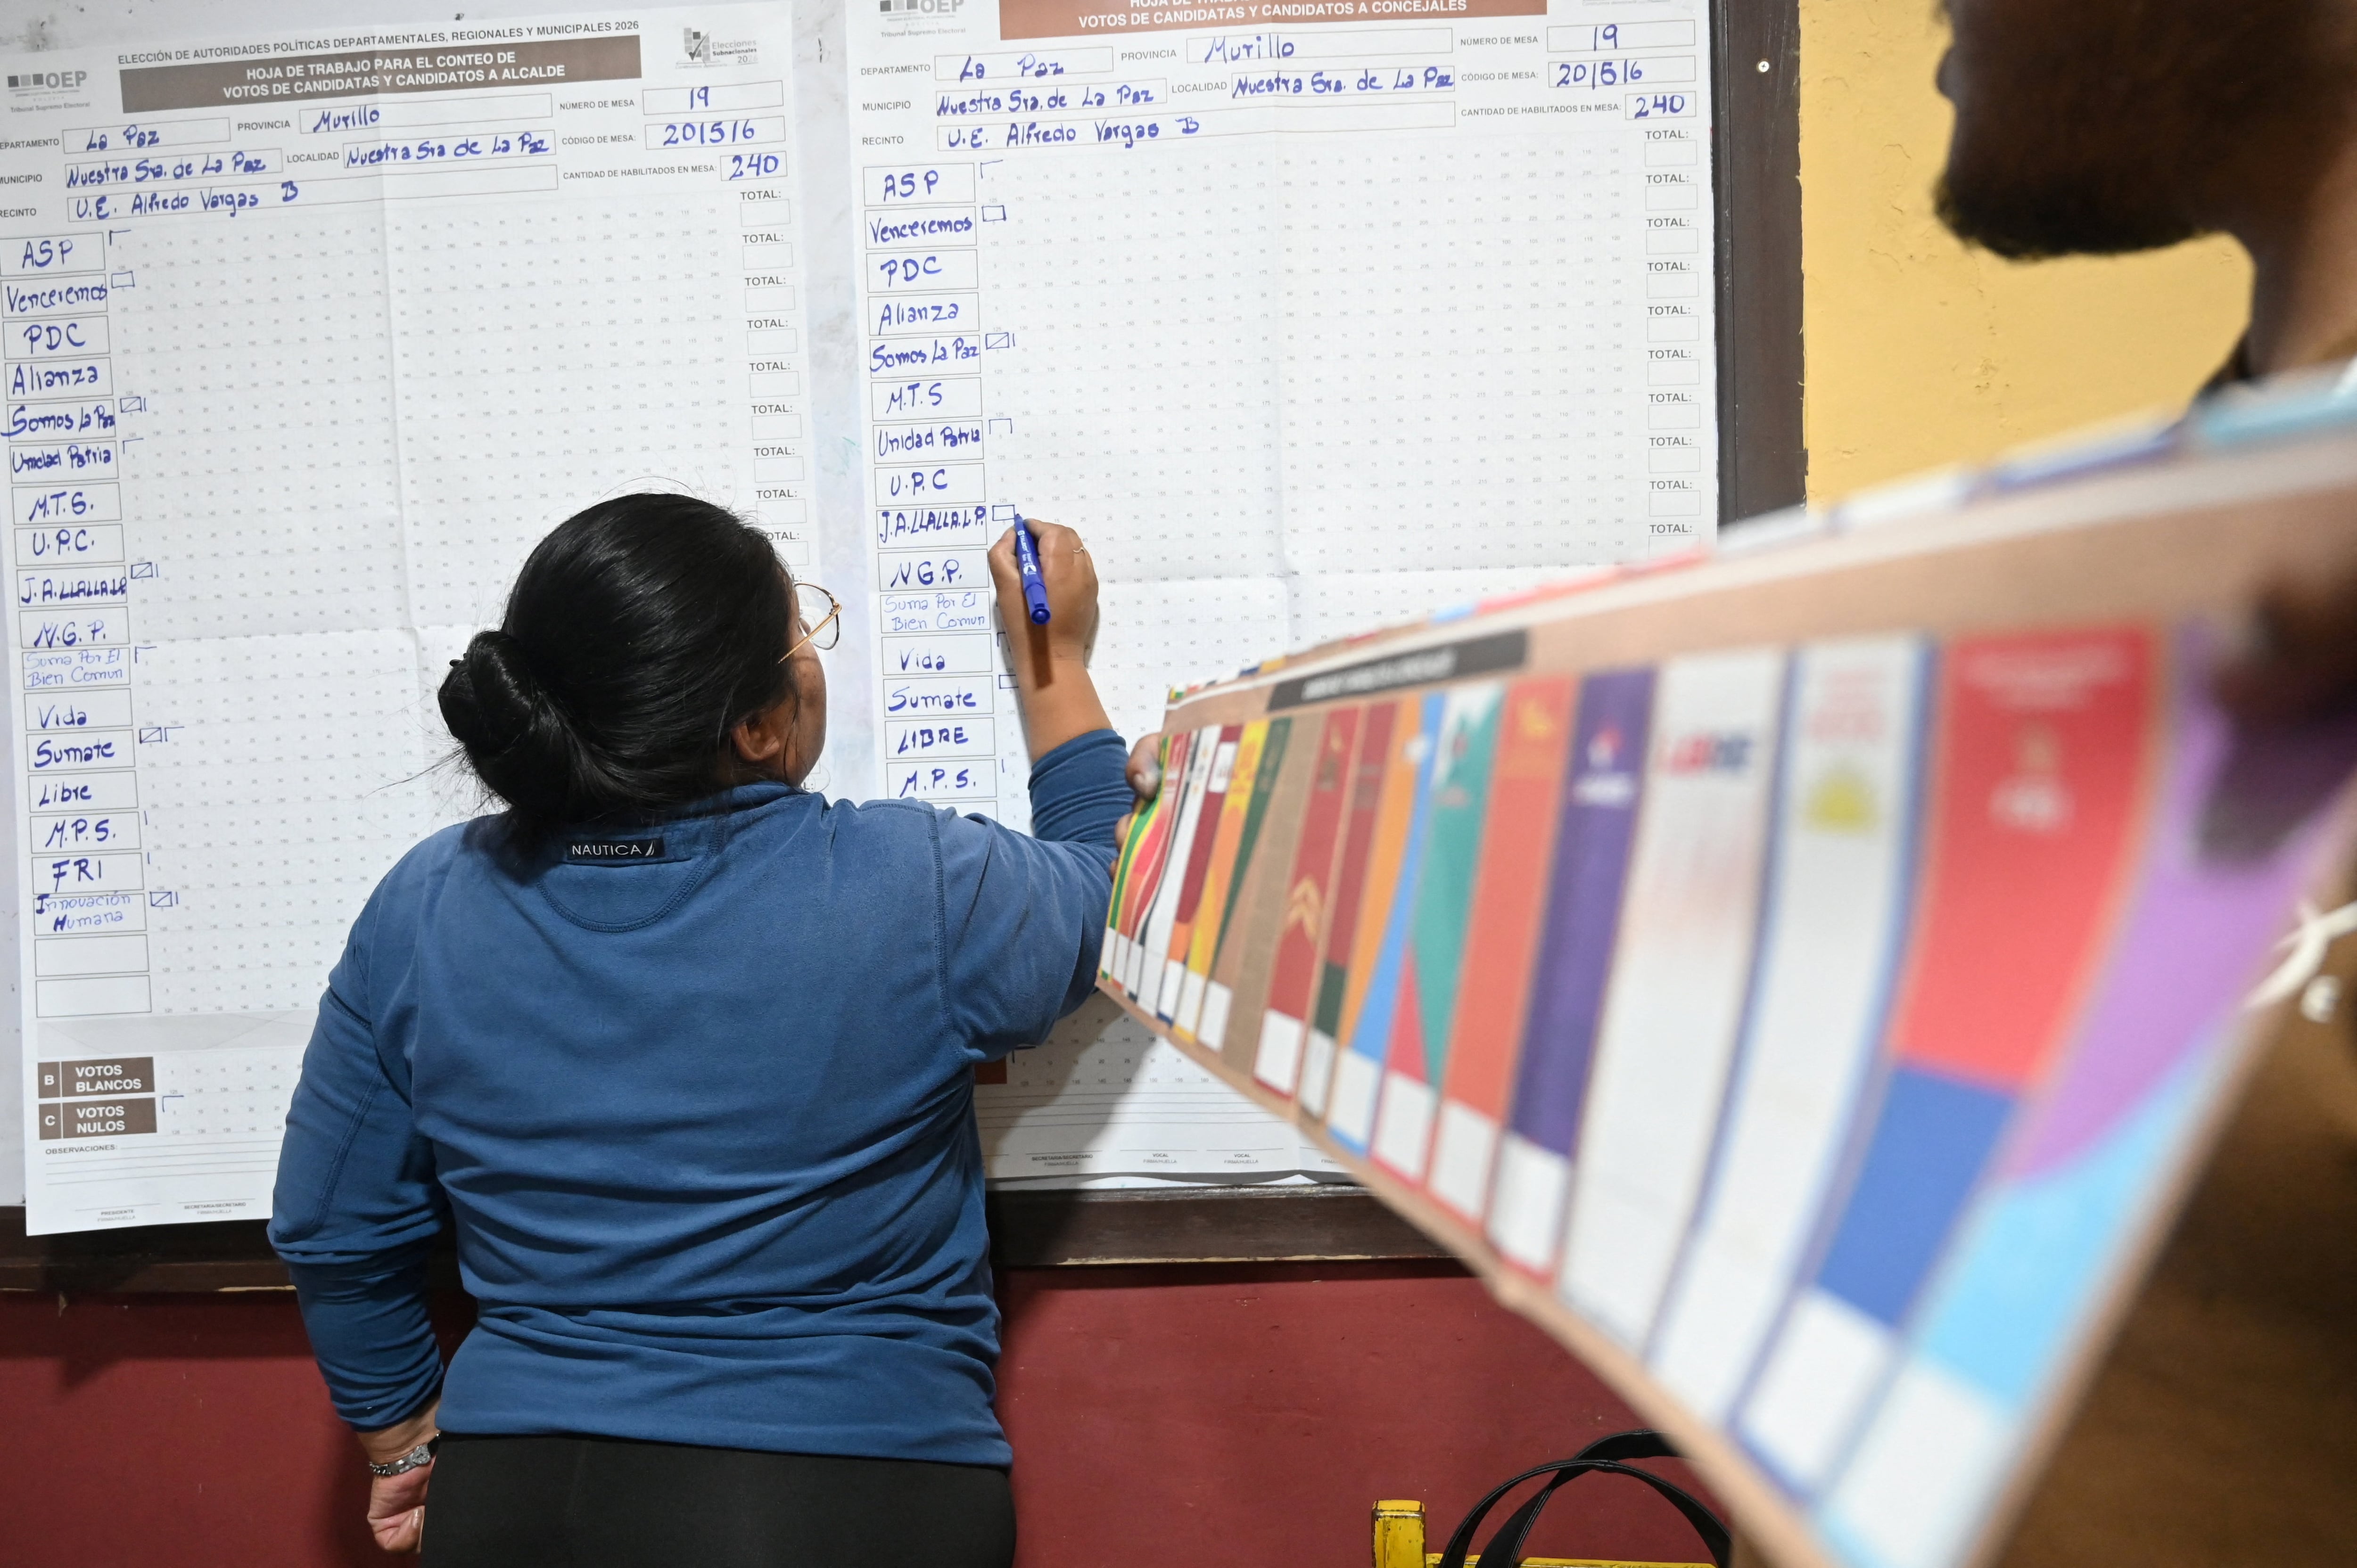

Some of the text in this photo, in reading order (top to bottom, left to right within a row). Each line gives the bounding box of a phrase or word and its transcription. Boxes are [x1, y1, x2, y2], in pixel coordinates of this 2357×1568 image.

[1079, 14, 1126, 28] VOTOS
[1131, 13, 1149, 25] DE
[1154, 7, 1244, 24] CANDIDATAS
[1249, 6, 1257, 17] Y
[1262, 2, 1354, 16] CANDIDATOS
[1359, 2, 1368, 13] A
[1372, 0, 1467, 13] CONCEJALES
[118, 21, 638, 64] ELECCIÓN DE AUTORIDADES POLÍTICAS DEPARTAMENTALES, REGIONALES Y MUNICIPALES 2026
[1204, 33, 1294, 64] Murillo
[1593, 24, 1618, 51] 19
[247, 52, 516, 80] HOJA DE TRABAJO PARA EL CONTEO DE
[1121, 49, 1176, 60] PROVINCIA
[861, 65, 930, 75] DEPARTAMENTO
[960, 53, 1064, 80] La Paz
[1461, 72, 1493, 82] CÓDIGO
[1510, 71, 1539, 80] MESA:
[1558, 61, 1642, 90] 201516
[46, 71, 87, 88] OEP
[223, 65, 565, 98] VOTOS DE CANDIDATAS Y CANDIDATOS A ALCALDE
[1172, 82, 1227, 93] LOCALIDAD
[1234, 72, 1302, 97] Nuestra
[1357, 69, 1383, 90] de
[1393, 68, 1414, 90] La
[1424, 66, 1453, 88] Paz
[560, 99, 595, 110] NÚMERO
[690, 87, 709, 109] 19
[863, 101, 911, 110] MUNICIPIO
[937, 91, 1001, 116] Nuestra
[1048, 87, 1068, 108] de
[1082, 85, 1105, 107] La
[1117, 84, 1154, 105] Paz
[1634, 95, 1684, 118] 240
[238, 121, 290, 131] PROVINCIA
[313, 105, 380, 132] Murillo
[87, 124, 160, 151] La Paz
[663, 119, 755, 147] 201516
[863, 136, 903, 145] RECINTO
[1007, 122, 1076, 147] Alfredo
[1094, 119, 1160, 149] Vargas
[1176, 116, 1200, 135] B
[1645, 130, 1688, 140] TOTAL:
[287, 152, 339, 163] LOCALIDAD
[346, 143, 412, 167] Nuestra
[454, 139, 481, 156] de
[492, 135, 510, 154] La
[518, 132, 549, 153] Paz
[66, 162, 128, 188] Nuestra
[173, 158, 193, 179] de
[202, 154, 223, 175] La
[232, 151, 266, 173] Paz
[563, 171, 605, 179] CANTIDAD
[621, 167, 675, 176] HABILITADOS
[691, 164, 717, 172] MESA:
[729, 155, 779, 181] 240
[132, 190, 189, 215] Alfredo
[200, 188, 259, 218] Vargas
[281, 181, 298, 202] B
[740, 190, 781, 200] TOTAL:
[870, 217, 972, 243] Venceremos
[7, 284, 107, 312] Venceremos
[879, 303, 959, 335] Alianza
[1648, 306, 1690, 315] TOTAL:
[870, 337, 980, 372] Somos La Paz
[749, 362, 790, 371] TOTAL:
[13, 364, 98, 394] Alianza
[1, 405, 73, 436] Somos
[79, 406, 91, 432] La
[879, 426, 980, 456] Unidad Patria
[756, 490, 797, 499] TOTAL:
[1649, 481, 1692, 490] TOTAL:
[900, 648, 945, 671] Vida
[889, 686, 976, 712] Sumate
[39, 705, 86, 728] Vida
[898, 727, 969, 754] LIBRE
[35, 739, 115, 767] Sumate
[39, 781, 91, 807] Libre
[573, 845, 642, 855] NAUTICA
[36, 891, 131, 913] Innovación
[54, 910, 123, 932] Humana
[45, 1075, 54, 1085] B
[75, 1065, 122, 1077] VOTOS
[76, 1079, 141, 1092] BLANCOS
[45, 1116, 55, 1125] C
[77, 1106, 124, 1118] VOTOS
[77, 1121, 125, 1133] NULOS
[46, 1145, 117, 1154] OBSERVACIONES:
